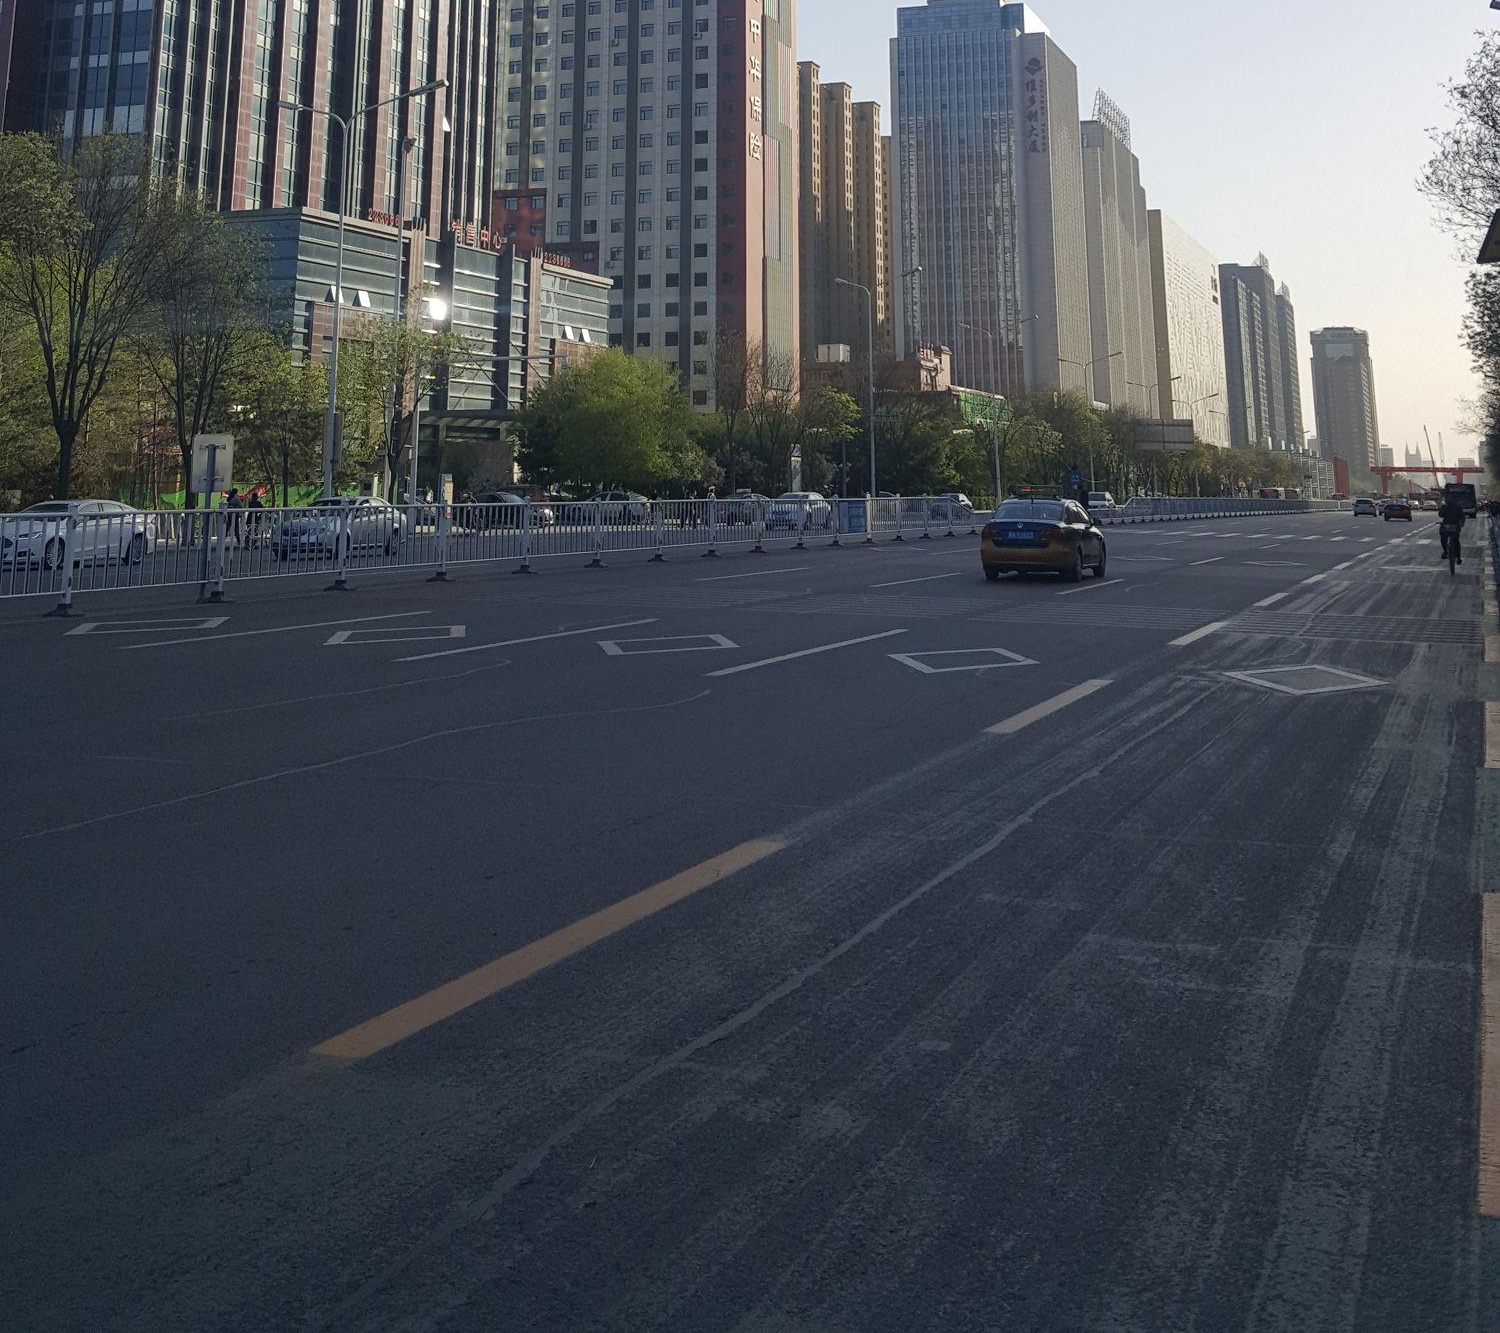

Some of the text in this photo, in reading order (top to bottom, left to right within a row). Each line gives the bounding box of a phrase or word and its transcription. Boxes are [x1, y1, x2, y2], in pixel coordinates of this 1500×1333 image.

[748, 18, 761, 161] 中华保险
[451, 219, 502, 249] 销售中心
